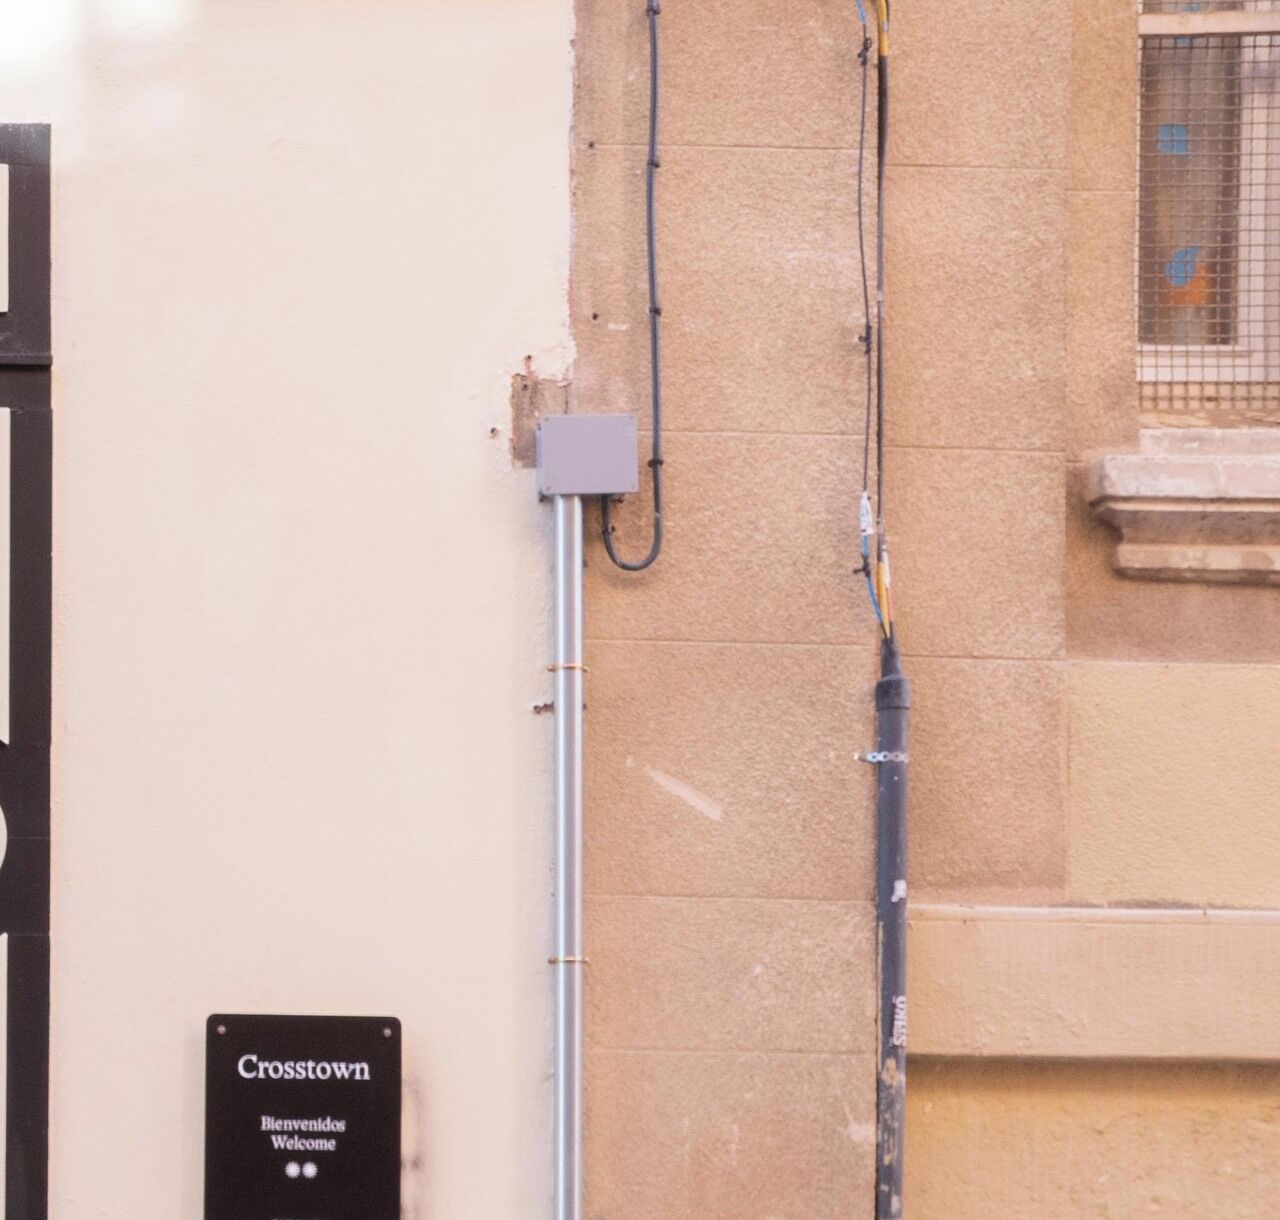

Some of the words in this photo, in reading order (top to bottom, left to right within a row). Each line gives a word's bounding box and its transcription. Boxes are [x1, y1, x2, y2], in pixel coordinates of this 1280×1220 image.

[237, 1054, 371, 1081] Crosstown
[260, 1115, 346, 1133] Bienvenidos
[271, 1134, 337, 1152] Welcome
